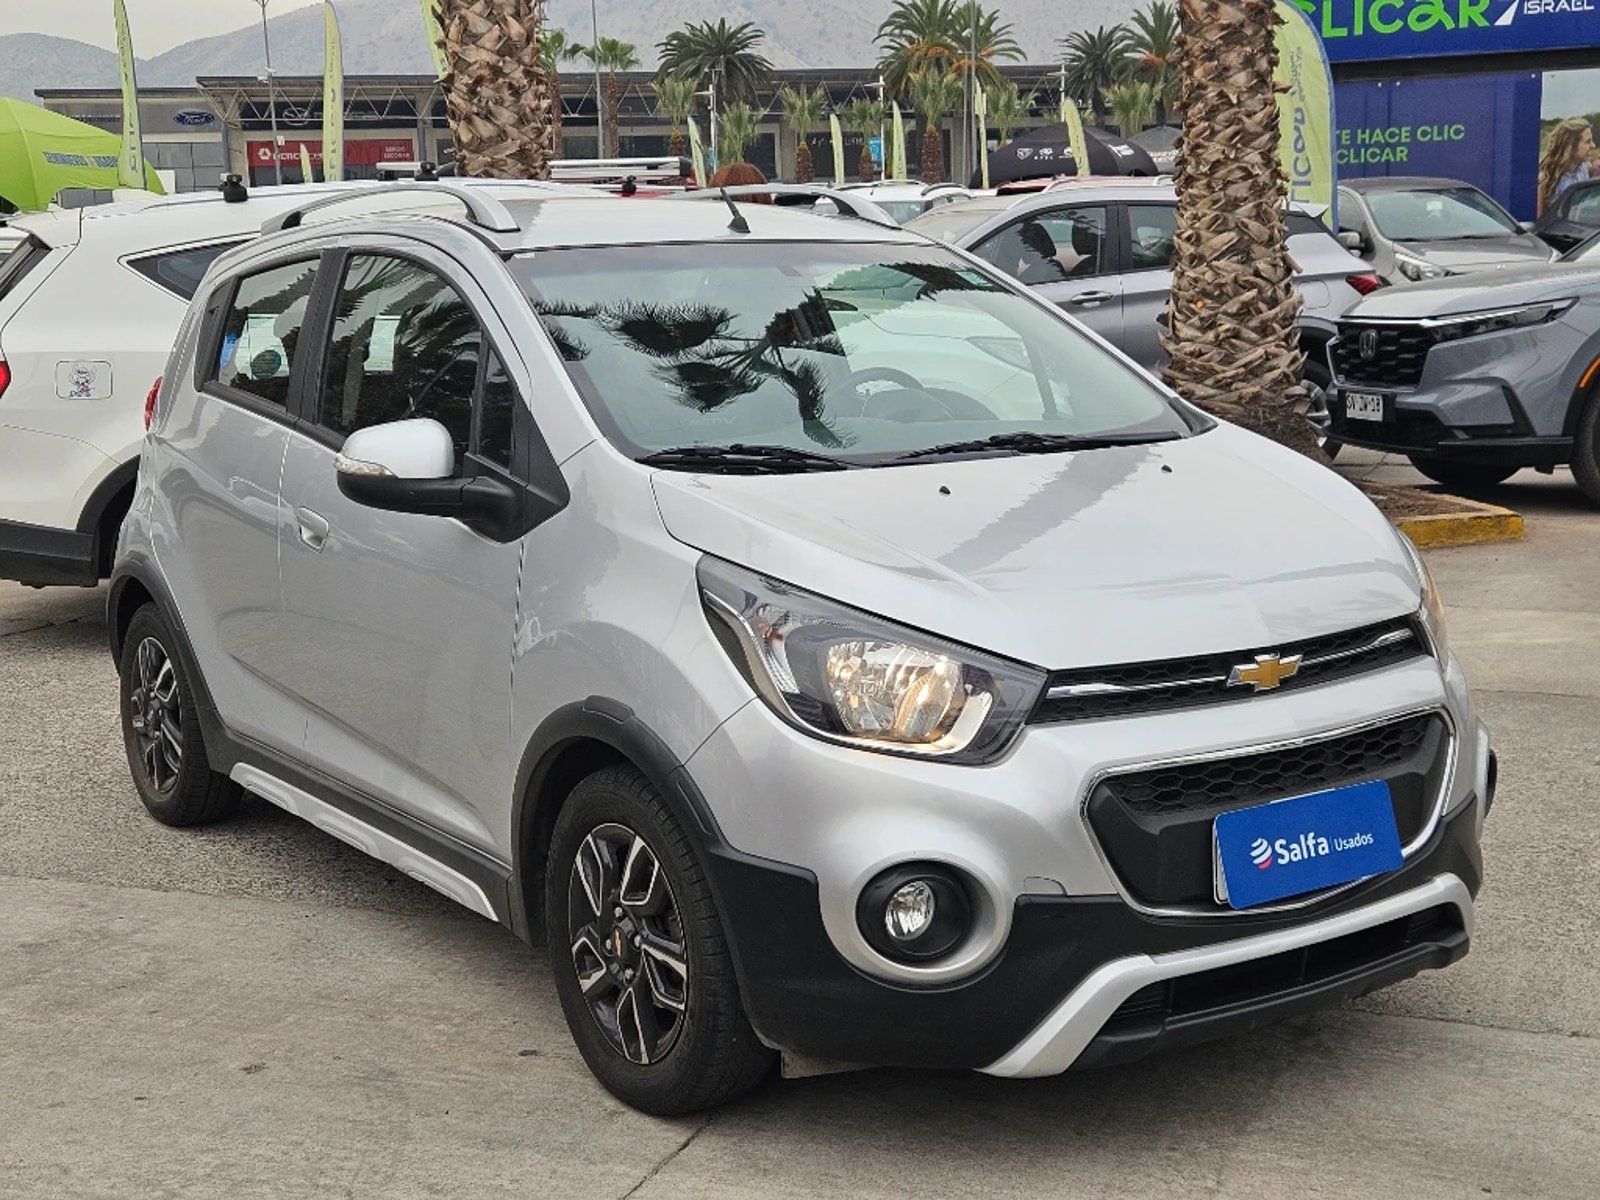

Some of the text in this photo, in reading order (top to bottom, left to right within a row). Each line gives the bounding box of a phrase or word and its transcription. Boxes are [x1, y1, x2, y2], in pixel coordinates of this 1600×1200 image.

[1523, 0, 1595, 14] ISRAEL
[1294, 0, 1490, 38] LICaR
[1357, 127, 1411, 145] HACE
[1416, 124, 1466, 141] CLIC
[1336, 147, 1409, 164] CLICAR
[1274, 832, 1374, 865] Salfa Usados
